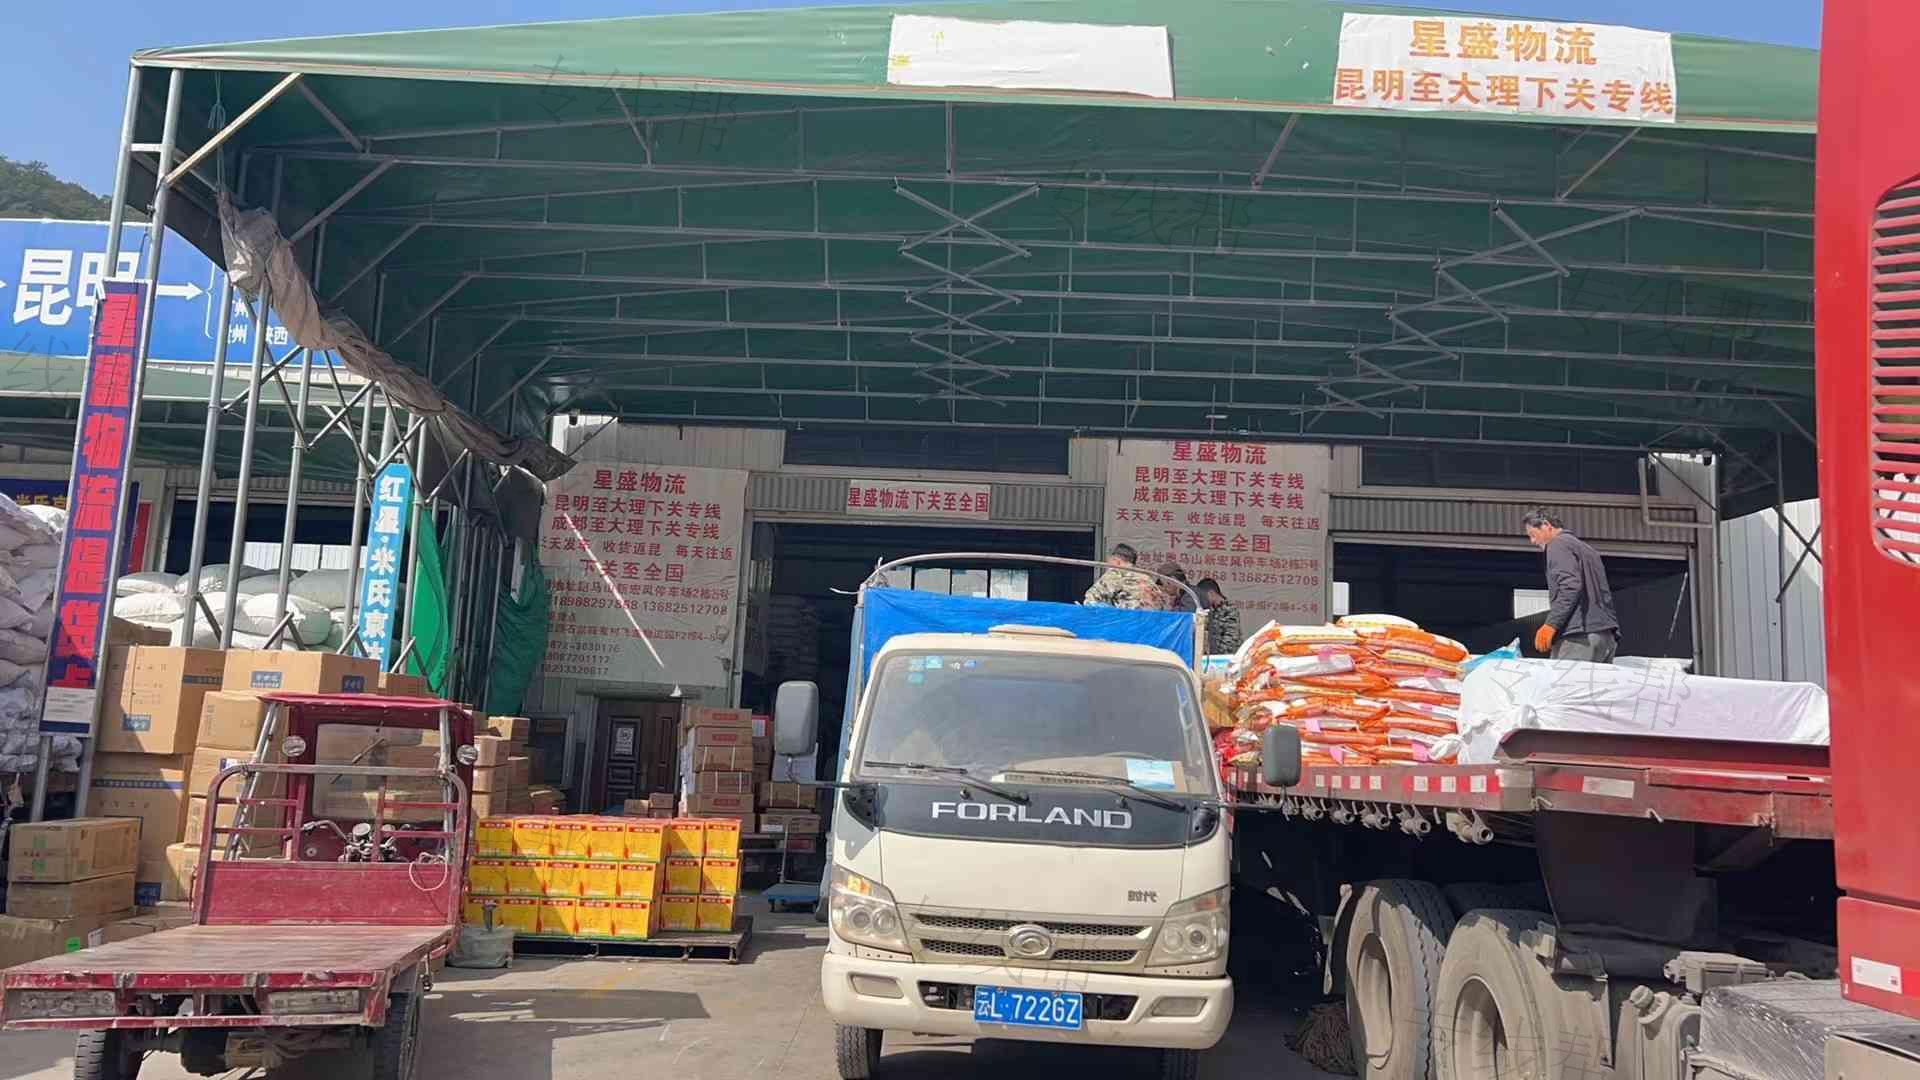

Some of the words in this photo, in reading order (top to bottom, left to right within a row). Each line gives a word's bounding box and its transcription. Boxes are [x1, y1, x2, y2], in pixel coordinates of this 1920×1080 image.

[1409, 20, 1597, 65] 星盛物流
[1336, 68, 1672, 114] 昆明至大理下关专线
[1172, 440, 1267, 465] 星盛物流
[593, 470, 687, 495] 星盛物流
[1135, 466, 1305, 490] 昆明至大理下关专线
[554, 494, 721, 520] 昆明至大理下关专线
[848, 487, 989, 513] 星盛物流下关至全国
[1133, 486, 1305, 510] 成都至大理下关专线
[551, 516, 721, 540] 成都至大理下关专线
[1116, 508, 1174, 522] 天天发车
[1261, 514, 1320, 530] 每天往返
[675, 544, 735, 561] 每天往返
[1164, 530, 1272, 553] 下关至全国
[580, 558, 685, 583] 下关至全国
[931, 802, 1133, 829] FORLAND
[1127, 889, 1158, 903] 时代
